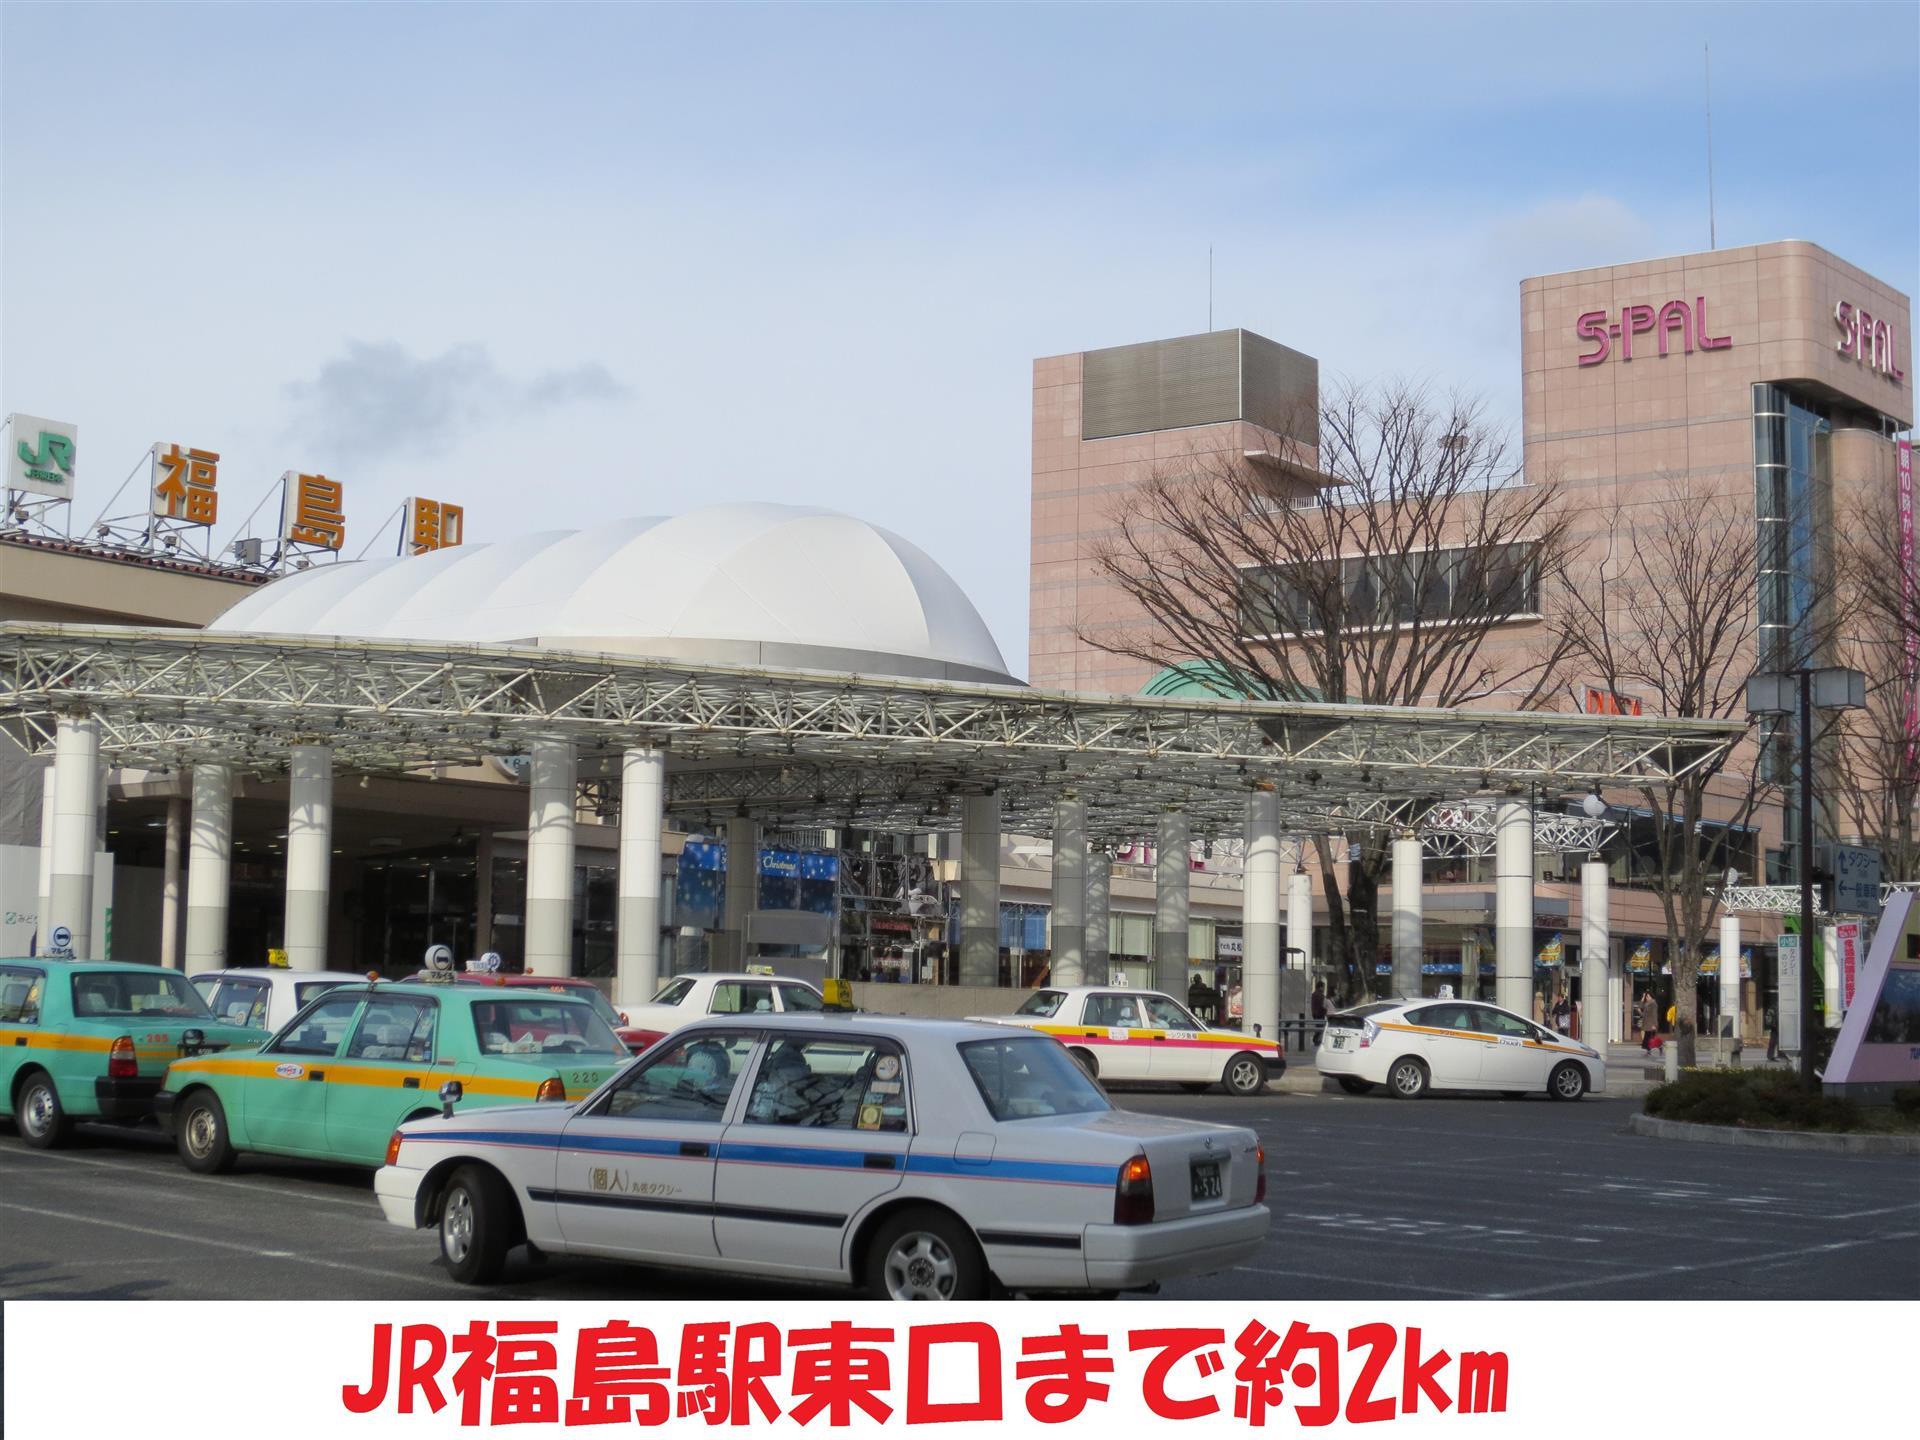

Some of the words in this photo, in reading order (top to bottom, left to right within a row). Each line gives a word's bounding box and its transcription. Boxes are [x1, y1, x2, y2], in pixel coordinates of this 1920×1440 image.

[1577, 296, 1733, 368] S-PAL
[1834, 300, 1904, 381] S-PAL
[18, 432, 74, 471] JR
[1848, 851, 1879, 868] タクシー
